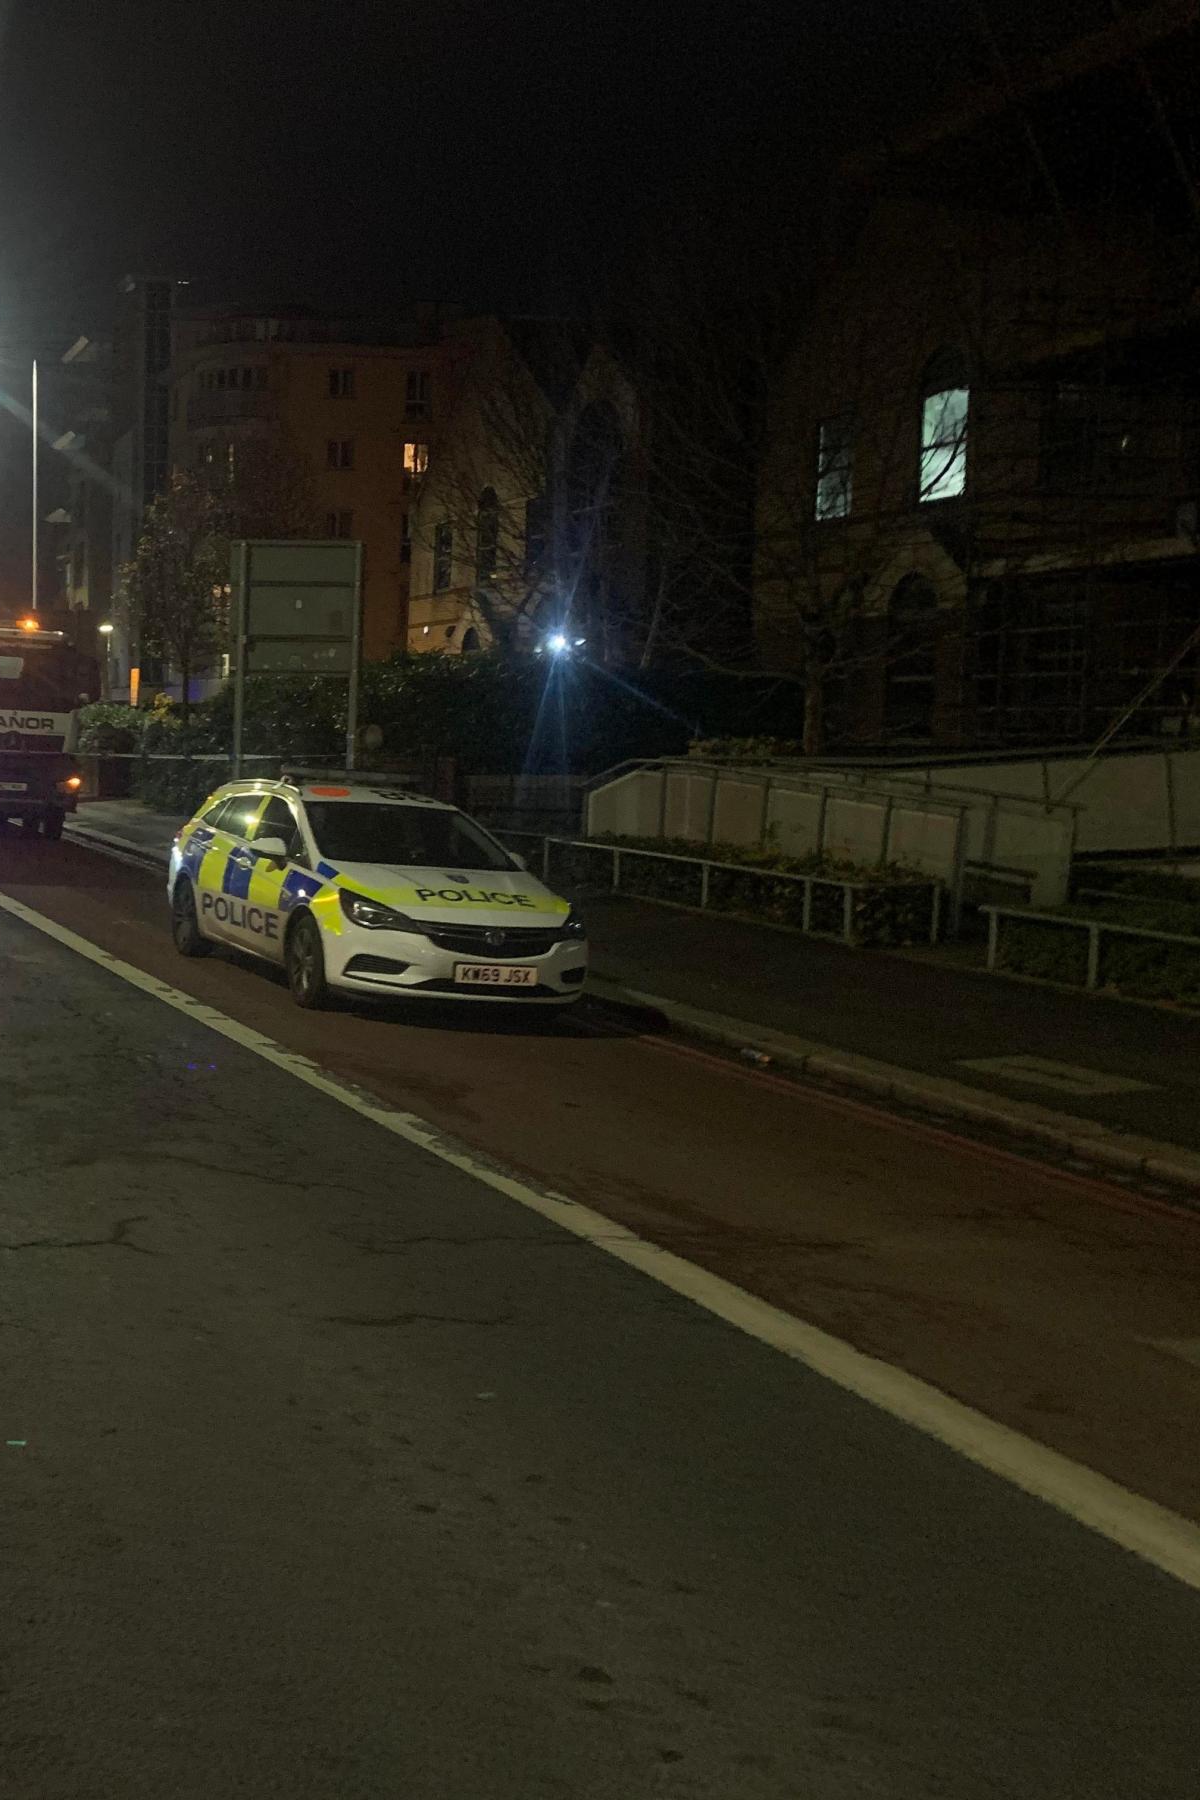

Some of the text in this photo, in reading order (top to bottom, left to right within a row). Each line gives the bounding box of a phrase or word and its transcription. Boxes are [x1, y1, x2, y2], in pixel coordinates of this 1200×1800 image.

[415, 888, 536, 908] POLICE
[202, 892, 279, 940] POLICE
[503, 969, 530, 983] JSX
